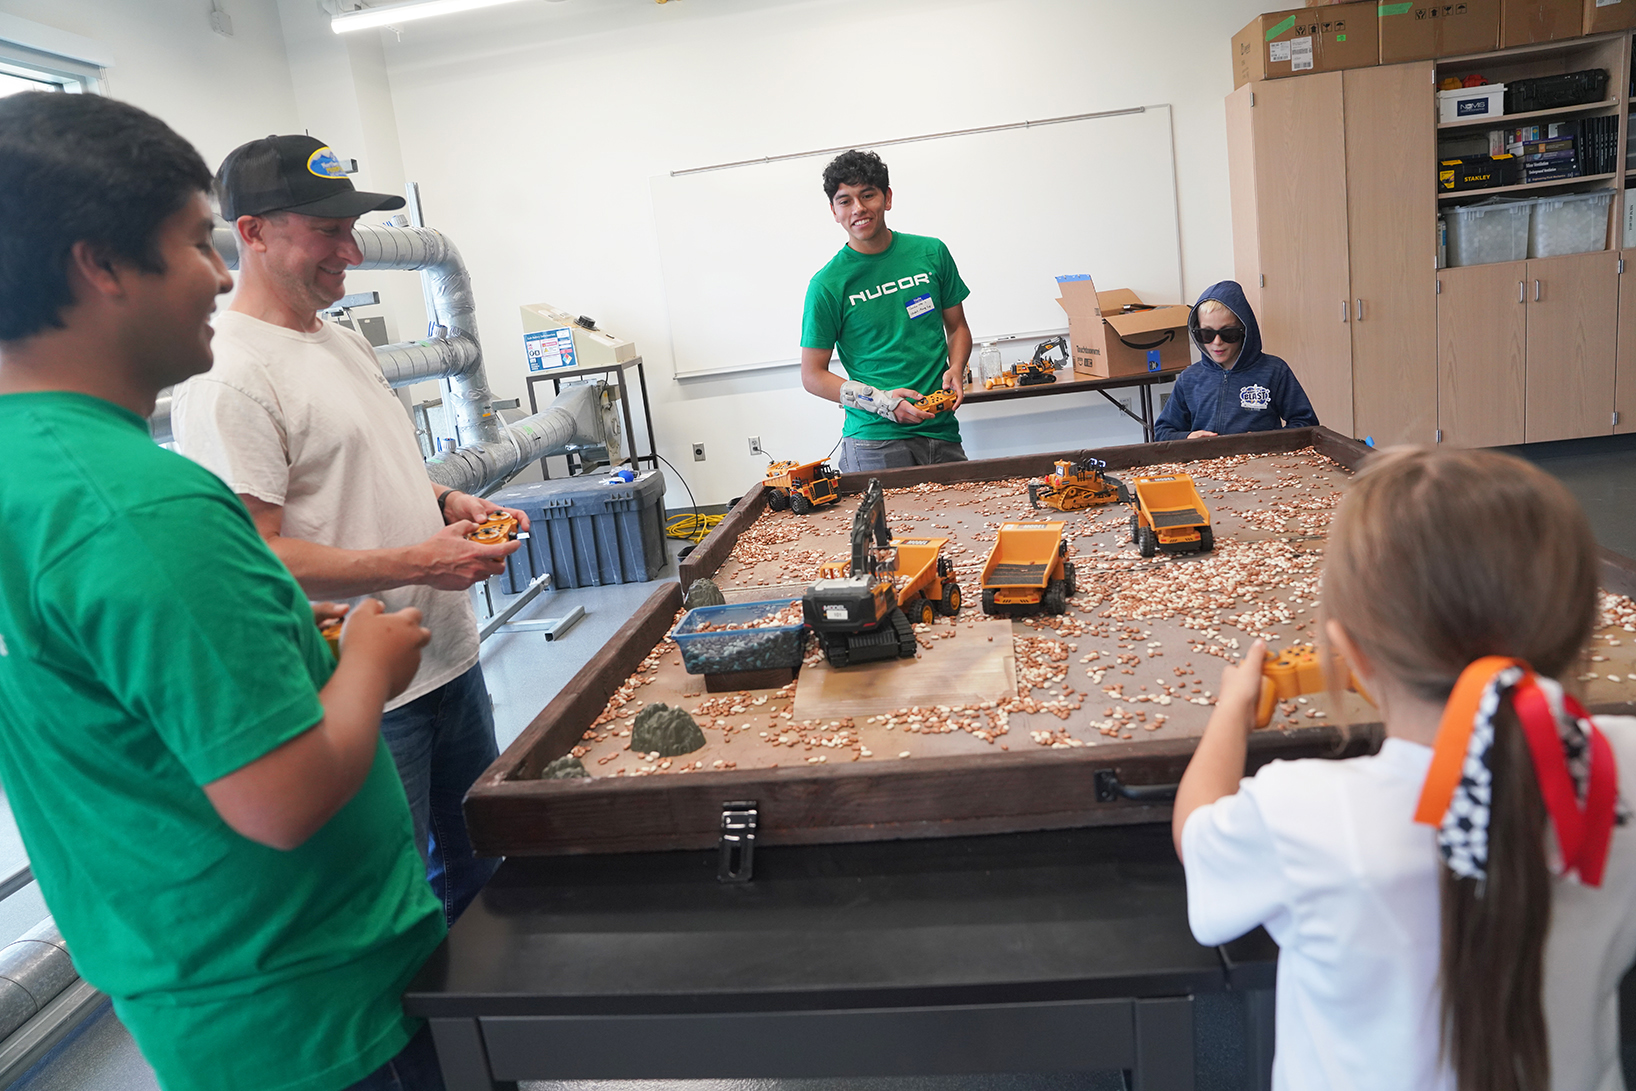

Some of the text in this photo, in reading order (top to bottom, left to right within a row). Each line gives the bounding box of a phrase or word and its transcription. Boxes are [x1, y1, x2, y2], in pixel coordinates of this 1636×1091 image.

[1464, 174, 1491, 182] STANLEY
[849, 273, 930, 306] NUCOR
[1244, 391, 1265, 400] BLAST
